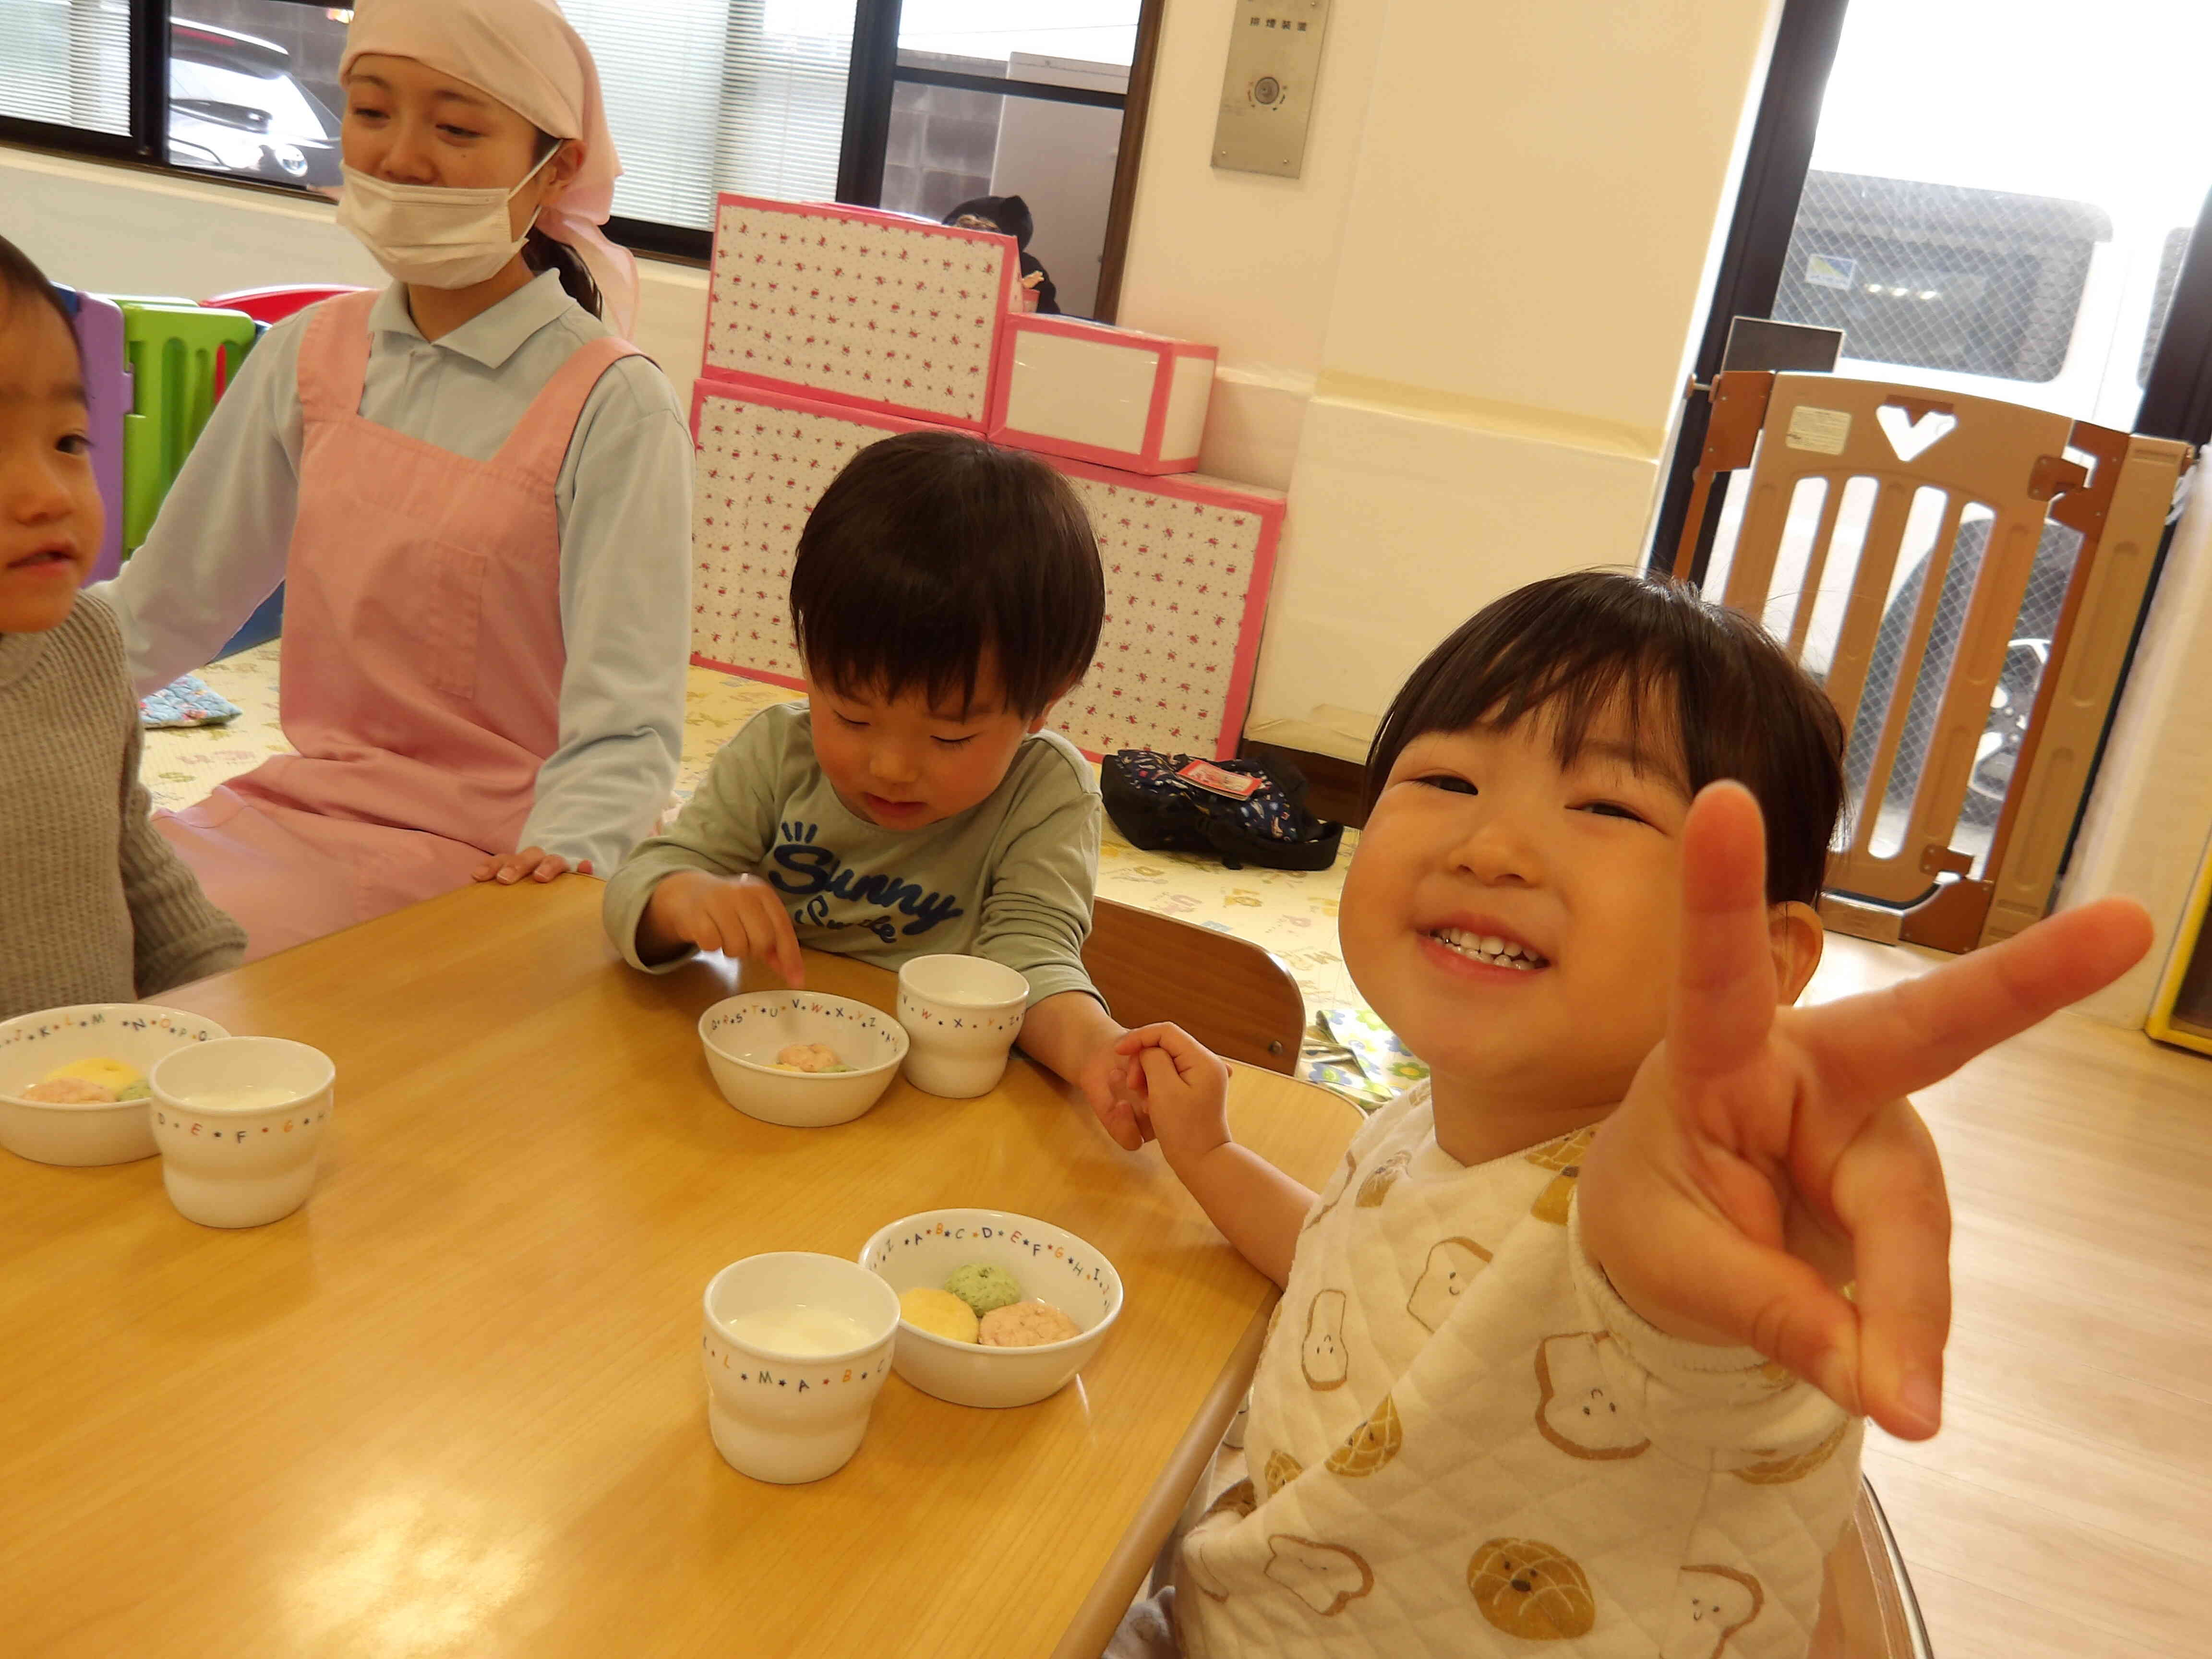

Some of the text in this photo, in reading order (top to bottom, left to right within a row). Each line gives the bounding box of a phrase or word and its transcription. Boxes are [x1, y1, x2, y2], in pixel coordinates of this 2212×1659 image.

[768, 844, 964, 936] Sunny
[793, 895, 897, 943] Smle
[769, 1009, 778, 1018] U
[792, 998, 800, 1009] V
[811, 1002, 823, 1013] W
[836, 1008, 844, 1017] X
[869, 1017, 876, 1027] Z
[953, 1018, 962, 1028] X
[14, 1029, 23, 1041] J
[39, 1025, 50, 1037] K
[65, 1014, 74, 1026] L
[92, 1014, 105, 1024] M
[132, 1018, 146, 1032] N
[160, 1018, 171, 1028] O
[191, 1123, 203, 1136] E
[237, 1130, 247, 1143] F
[914, 1233, 923, 1245] A
[936, 1223, 944, 1235] B
[956, 1228, 965, 1239] C
[982, 1227, 993, 1238] D
[1010, 1230, 1022, 1243] E
[1033, 1244, 1041, 1256] F
[1054, 1247, 1064, 1259] G
[1072, 1262, 1083, 1276] H
[1094, 1268, 1100, 1280] I
[759, 1370, 772, 1384] M
[798, 1379, 810, 1393] A
[842, 1369, 852, 1382] B
